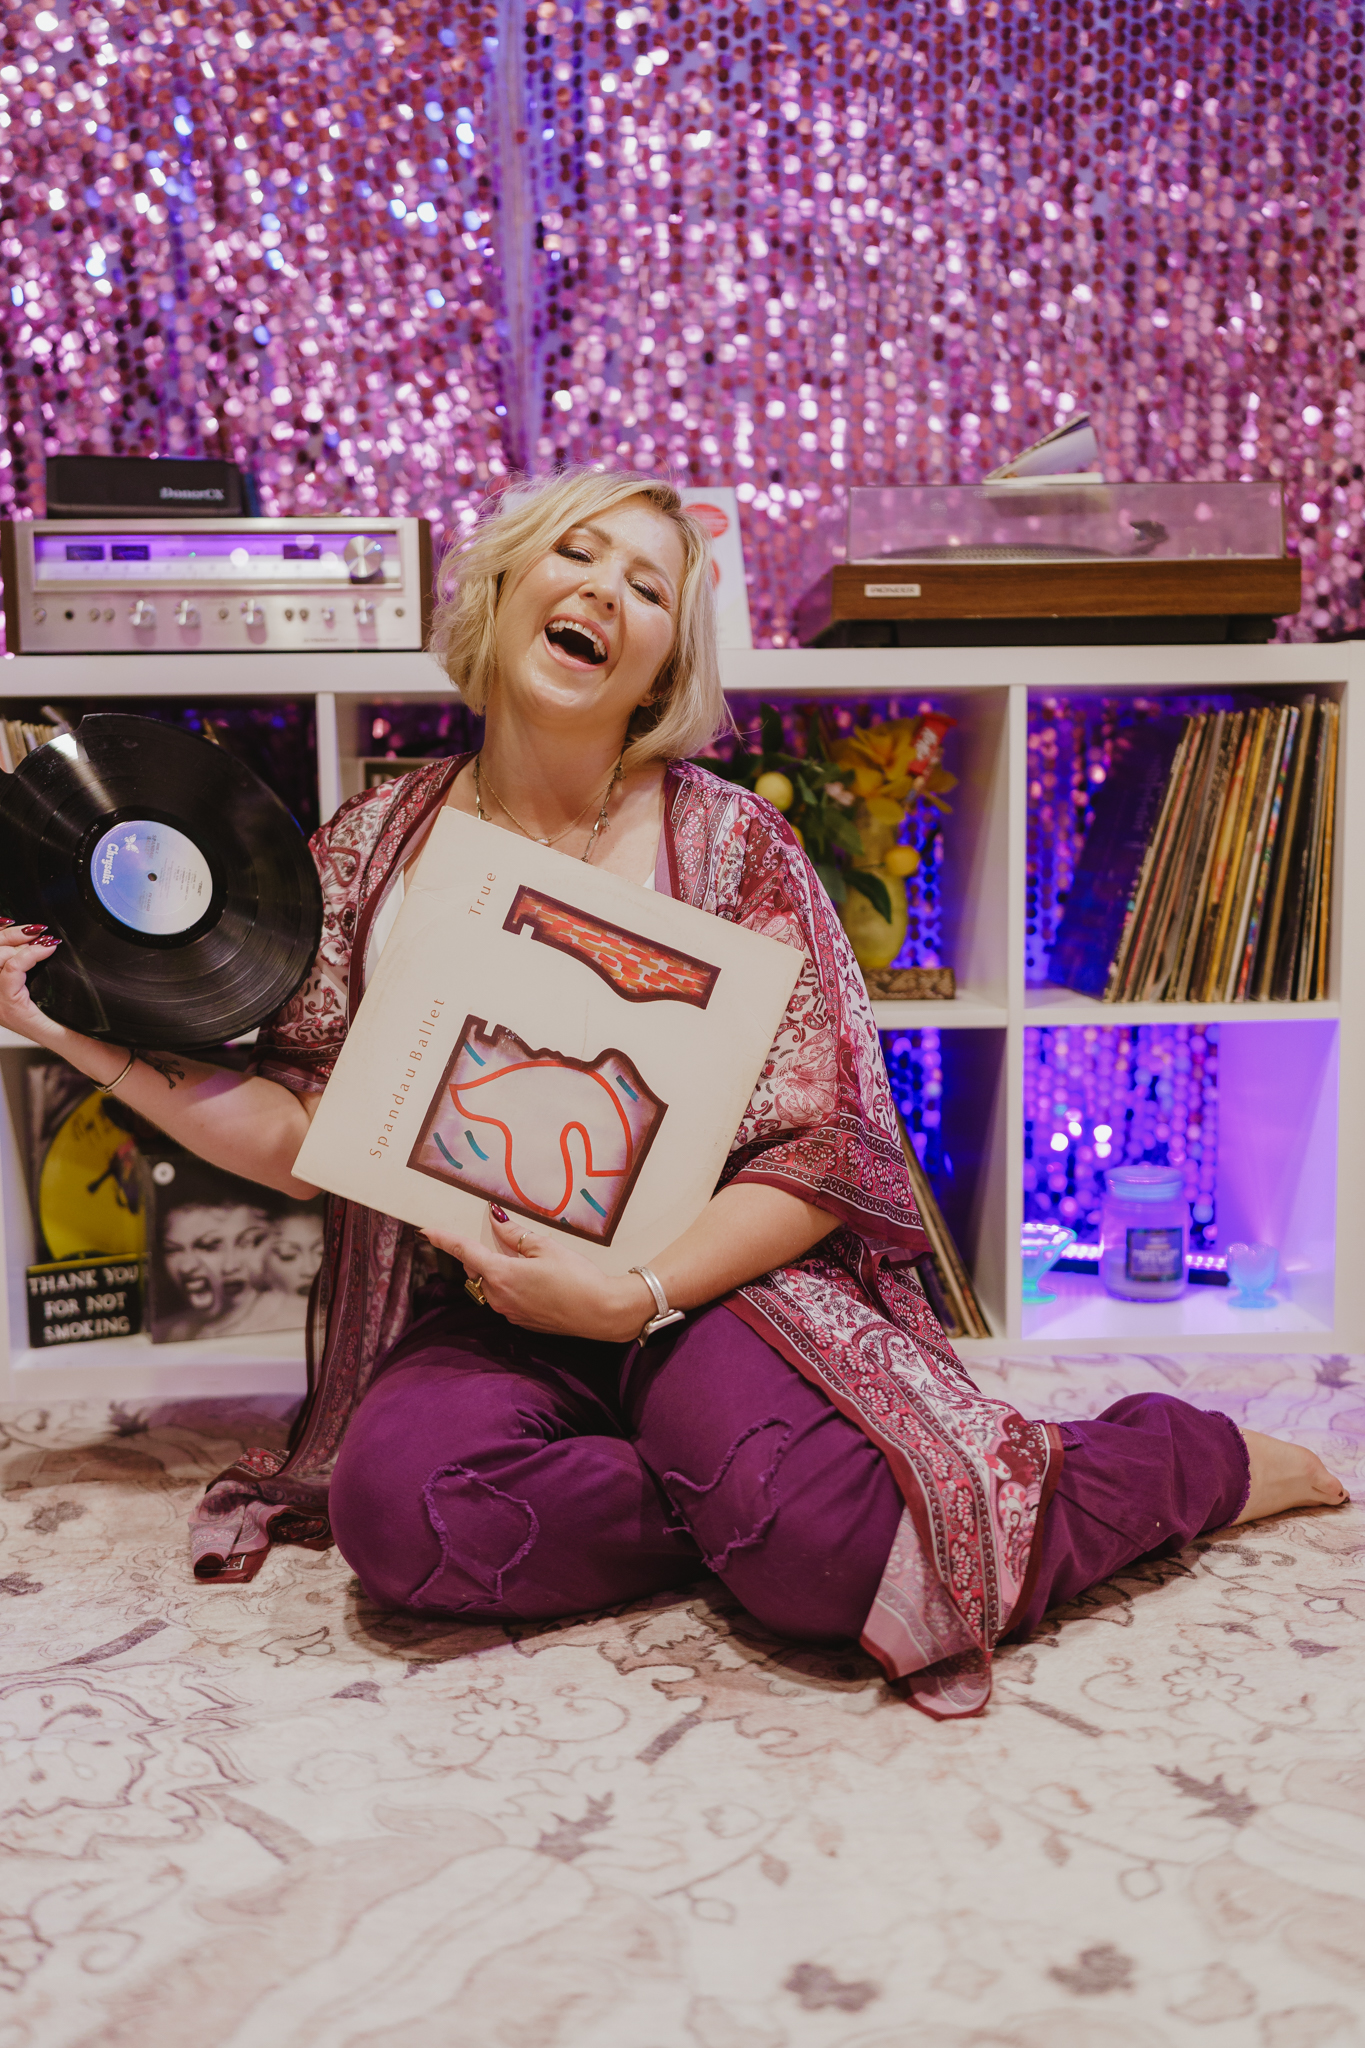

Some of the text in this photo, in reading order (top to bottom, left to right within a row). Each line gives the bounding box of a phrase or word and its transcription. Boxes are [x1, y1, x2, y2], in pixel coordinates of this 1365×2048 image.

[101, 843, 120, 885] Chrysalis
[468, 872, 497, 915] True
[369, 998, 446, 1159] Spandau Ballet
[27, 1264, 139, 1297] THANK YOU
[43, 1291, 128, 1321] FOR NOT
[43, 1315, 131, 1345] SMOKING
